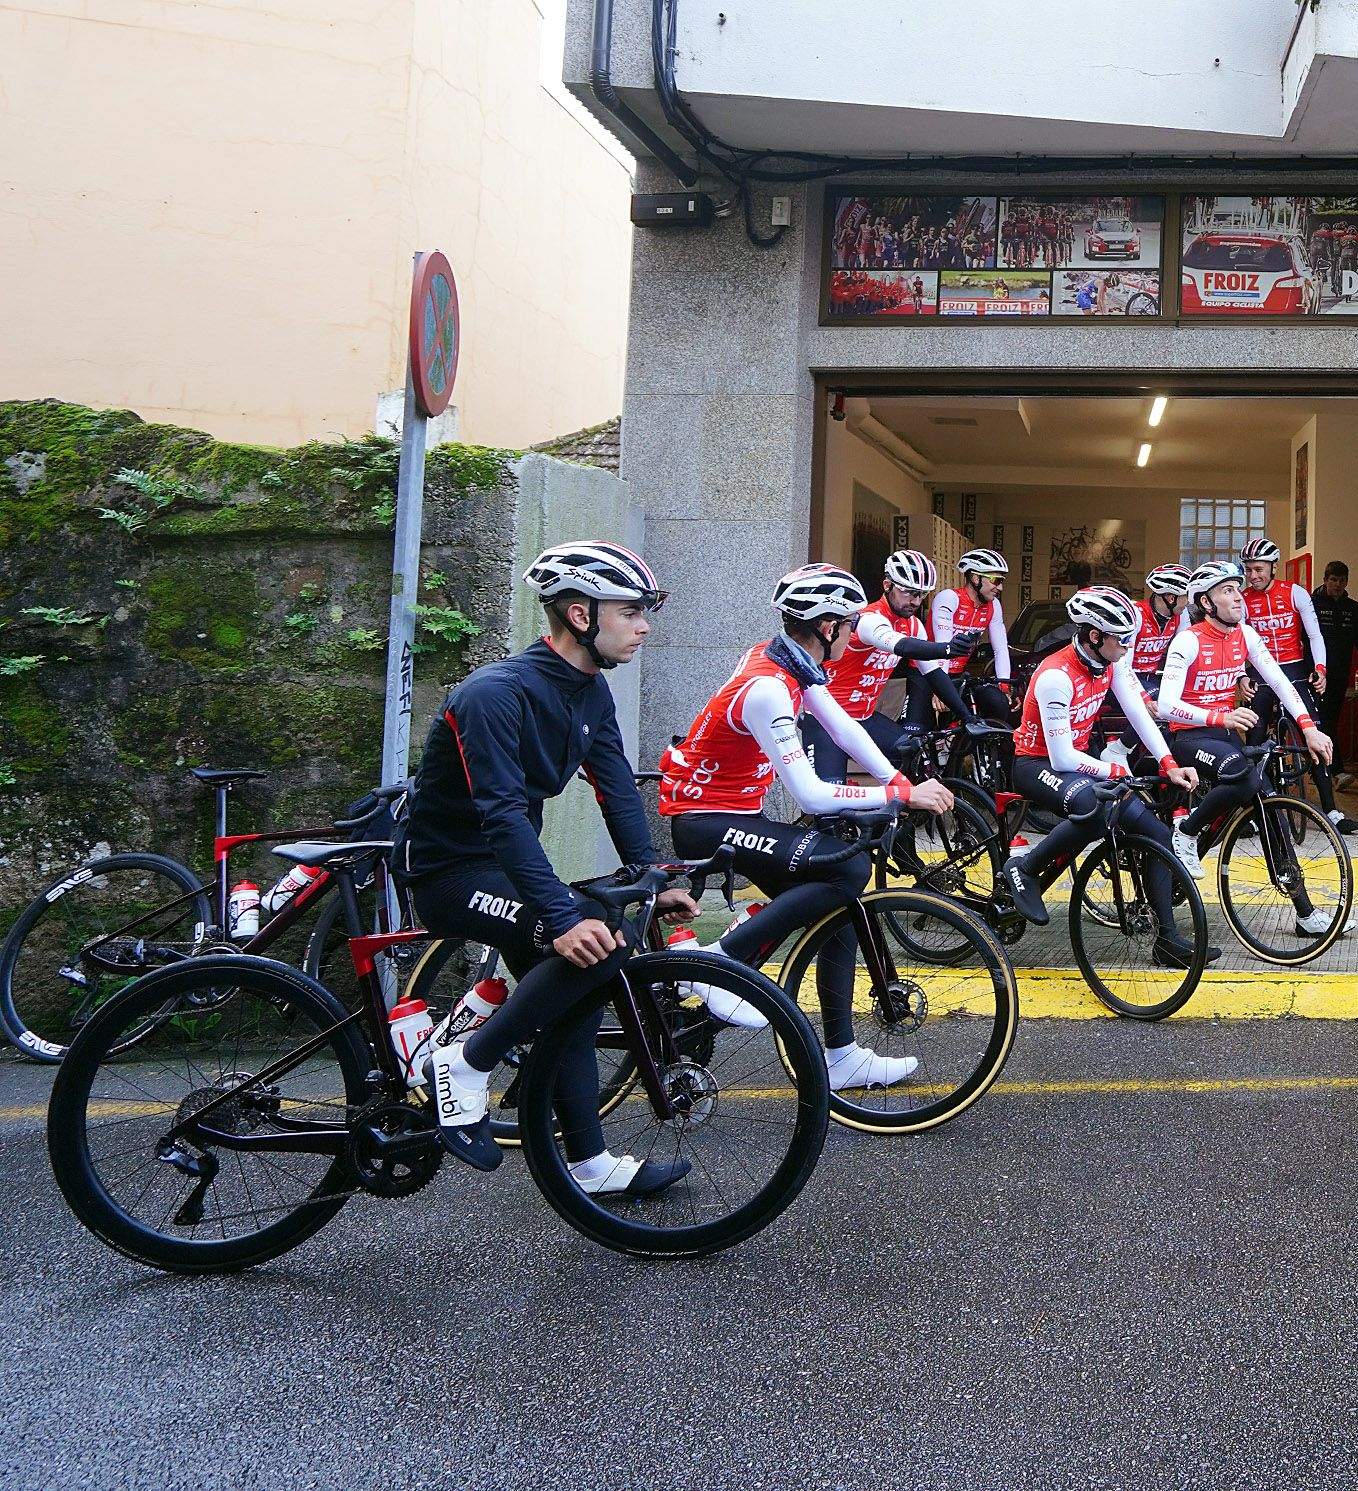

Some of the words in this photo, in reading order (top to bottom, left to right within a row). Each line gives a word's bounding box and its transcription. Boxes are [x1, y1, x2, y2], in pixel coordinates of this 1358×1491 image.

[1203, 273, 1260, 291] FROIZ
[942, 302, 975, 311] FROIZ
[987, 301, 1019, 311] FROIZ
[564, 568, 602, 591] Spiuk
[1251, 615, 1294, 631] FROIZ
[1170, 706, 1193, 720] FROIZ
[1195, 749, 1217, 766] FROIZ
[1038, 769, 1064, 791] FROIZ
[833, 787, 866, 798] FROIZ
[722, 828, 779, 855] FROIZ
[1010, 867, 1026, 892] FROIZ
[468, 890, 523, 923] FROIZ
[439, 1064, 461, 1118] nimbl
